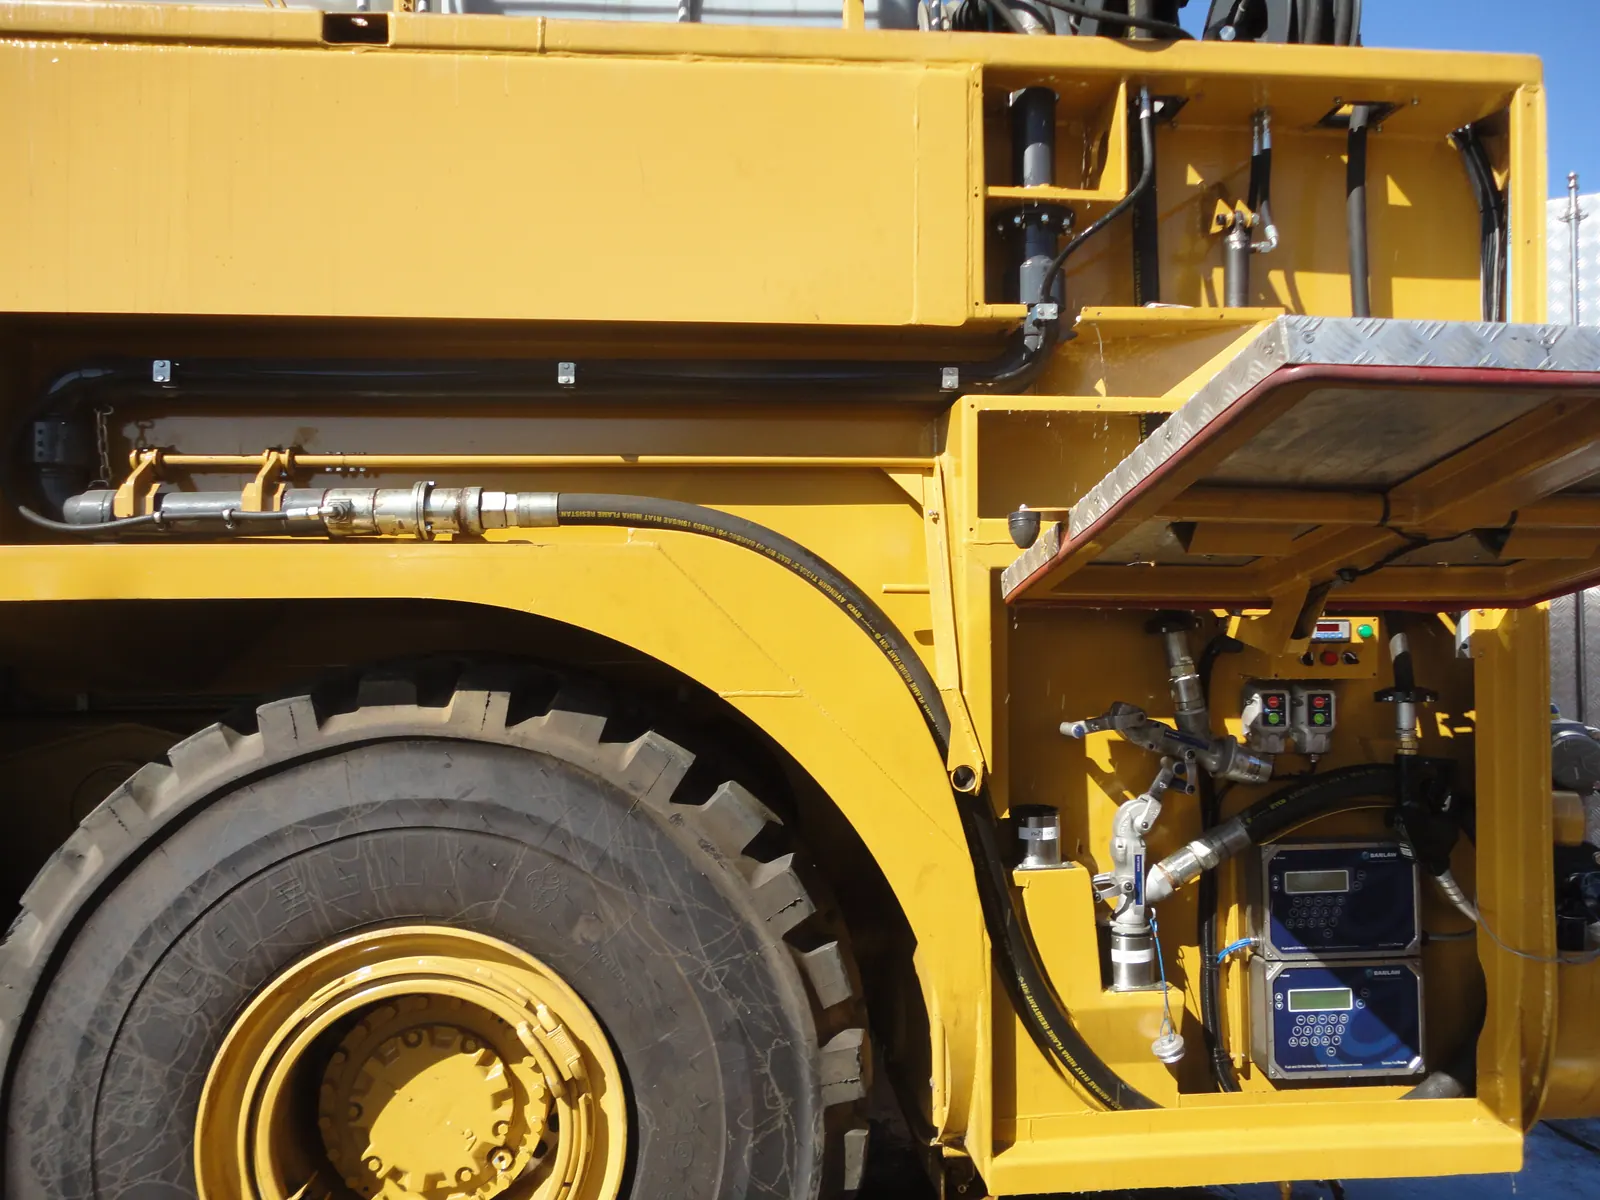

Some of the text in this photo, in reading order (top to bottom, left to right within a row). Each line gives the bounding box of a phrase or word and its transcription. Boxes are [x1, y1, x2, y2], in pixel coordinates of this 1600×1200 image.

[817, 579, 846, 604] AVENGER
[846, 602, 862, 618] RYCO
[1025, 994, 1050, 1030] RESISTANT
[1046, 1028, 1064, 1050] FLAME
[1061, 1049, 1077, 1067] MSHA
